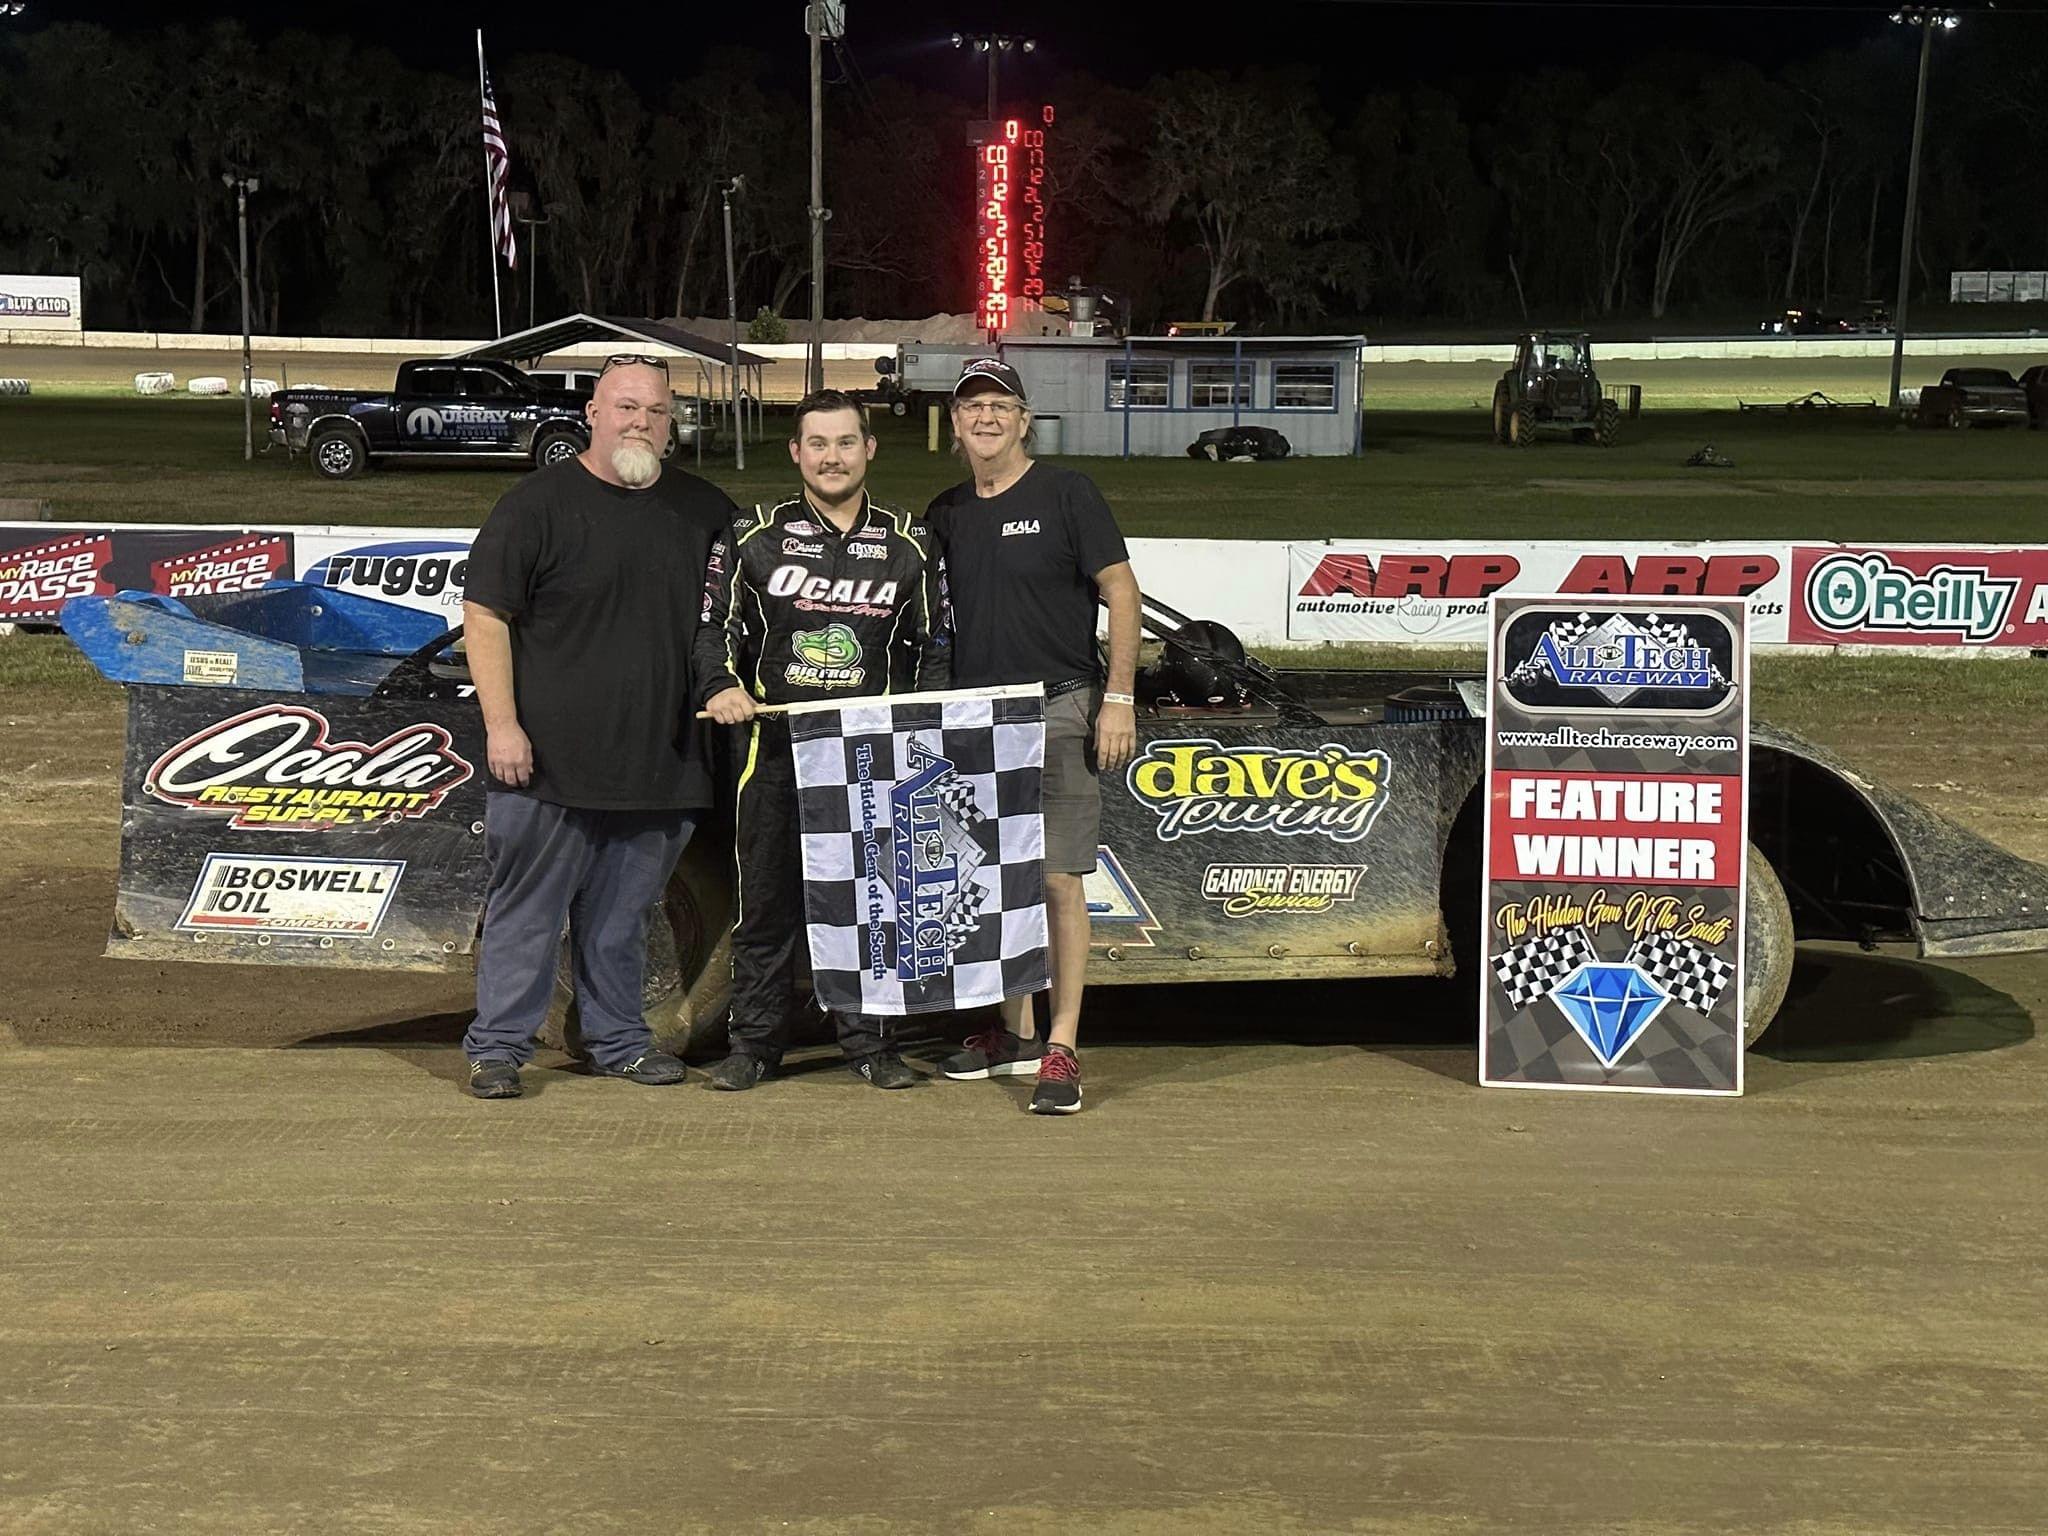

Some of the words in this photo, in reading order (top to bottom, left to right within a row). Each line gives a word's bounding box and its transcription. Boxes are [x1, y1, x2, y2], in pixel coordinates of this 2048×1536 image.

[8, 298, 33, 311] BLUE
[36, 298, 68, 312] GATOR
[1002, 519, 1040, 535] OCALA
[0, 569, 97, 605] PASS
[767, 565, 898, 605] OCALA
[1298, 554, 1522, 598] ARP
[1556, 554, 1780, 597] ARP
[1296, 600, 1395, 614] automotive
[1446, 601, 1489, 618] prod
[1818, 565, 2003, 629] O'Reilly
[1526, 632, 1600, 669] ALL
[1615, 634, 1710, 671] TECH
[1569, 671, 1702, 685] RACEWAY
[159, 713, 454, 792] Ocala
[1499, 727, 1736, 756] www.alltechraceway.com
[856, 744, 872, 780] The
[1135, 746, 1378, 803] dave's
[243, 806, 384, 823] SUPPLY
[858, 781, 876, 839] Hidden
[1161, 798, 1375, 833] Towing
[1510, 778, 1722, 824] FEATURE
[863, 841, 877, 881] Gem
[1512, 834, 1716, 880] WINNER
[227, 866, 385, 894] BOSWELL
[869, 884, 883, 902] of
[893, 802, 914, 970] RACEWAY
[1205, 868, 1287, 893] GARDNER
[1289, 869, 1357, 893] ENERGY
[217, 890, 271, 914] OIL
[868, 902, 881, 931] the
[914, 852, 960, 977] TECH
[1496, 903, 1527, 945] The
[1527, 895, 1585, 936] Hidden
[1585, 889, 1623, 934] Gem
[1625, 891, 1653, 941] Of
[1649, 896, 1683, 932] The
[1674, 905, 1733, 945] South
[256, 917, 359, 930] COMPANY
[870, 931, 887, 980] South
